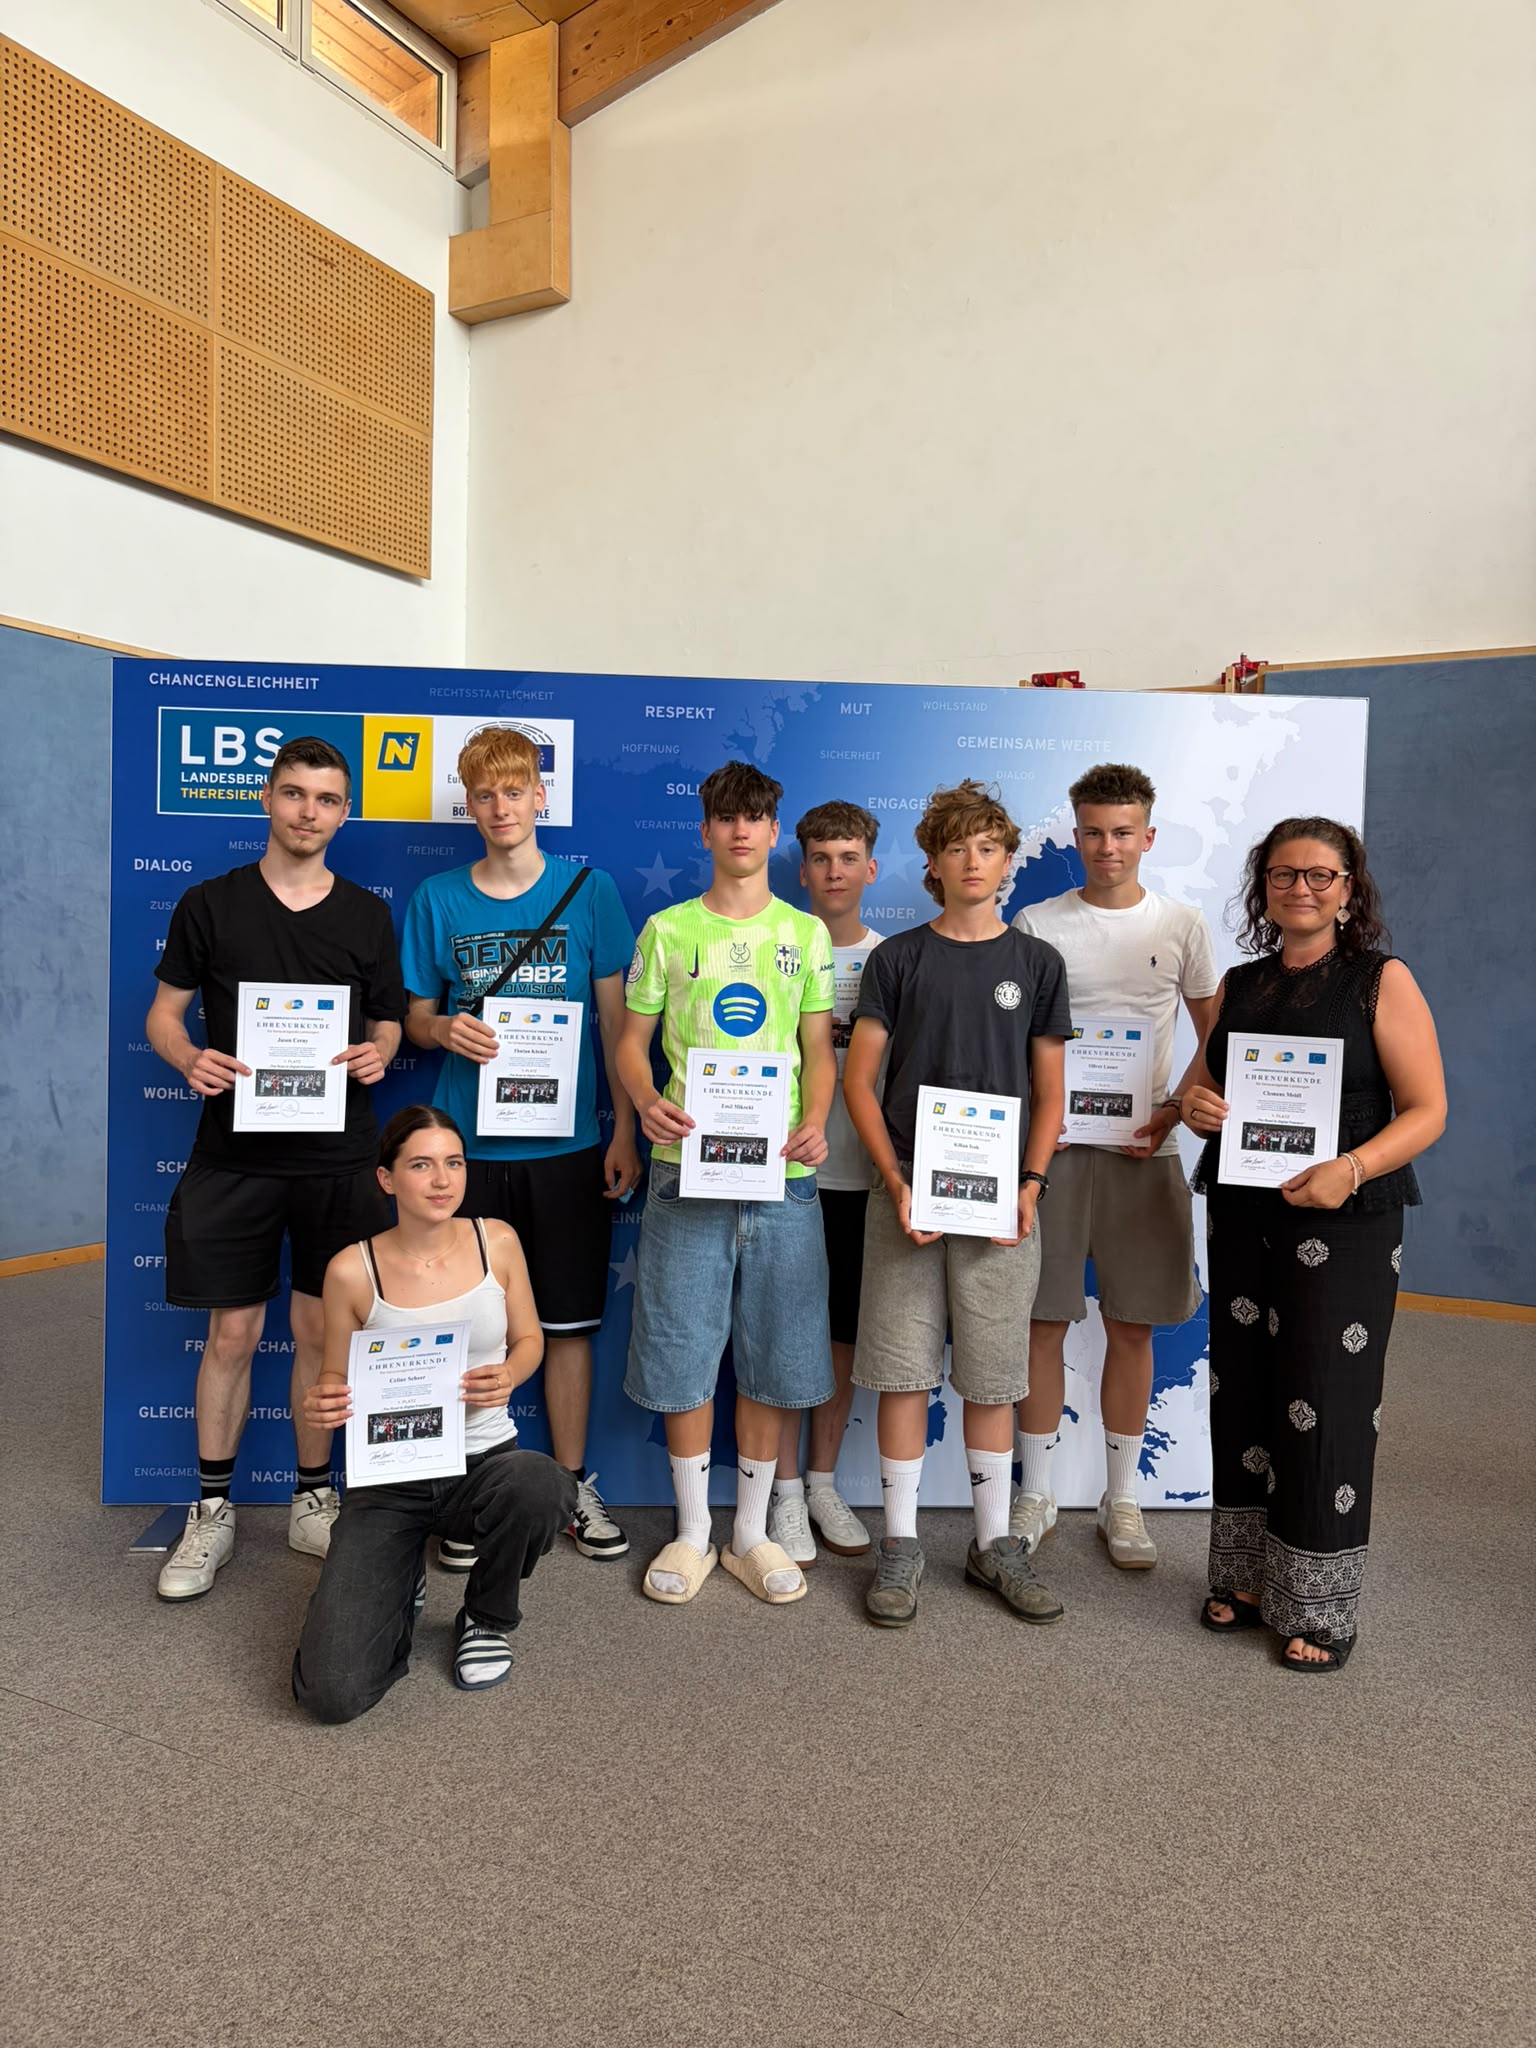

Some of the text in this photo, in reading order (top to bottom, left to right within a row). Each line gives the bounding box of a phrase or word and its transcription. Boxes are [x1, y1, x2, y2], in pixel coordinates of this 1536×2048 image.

[149, 672, 319, 690] CHANCENGLEICHHEIT
[429, 687, 555, 700] RECHTSSTAATLICHKEIT
[840, 703, 873, 716] MUT
[922, 701, 988, 712] WOHLSTAND
[645, 706, 716, 720] RESPEKT
[181, 725, 284, 767] LBS
[621, 743, 680, 754] HOFFNUNG
[957, 736, 1112, 752] GEMEINSAME WERTE
[820, 750, 881, 761] SICHERHEIT
[181, 772, 268, 785] LANDESBER
[996, 770, 1035, 781] DIALOG
[868, 797, 928, 810] ENGAGE
[634, 820, 702, 831] VERANTWOR
[407, 846, 455, 857] FREIHEIT
[134, 858, 193, 872] DIALOG
[503, 983, 566, 995] DIVISION
[256, 1021, 331, 1029] EHRENURKUNDE
[499, 1034, 564, 1042] EHRENURKUNDE
[1245, 1073, 1323, 1085] EHRENURKUNDE
[703, 1087, 774, 1097] EHRENURKUNDE
[368, 1357, 449, 1371] EHRENURKUNDE
[134, 1467, 200, 1478] ENGAGEMEN
